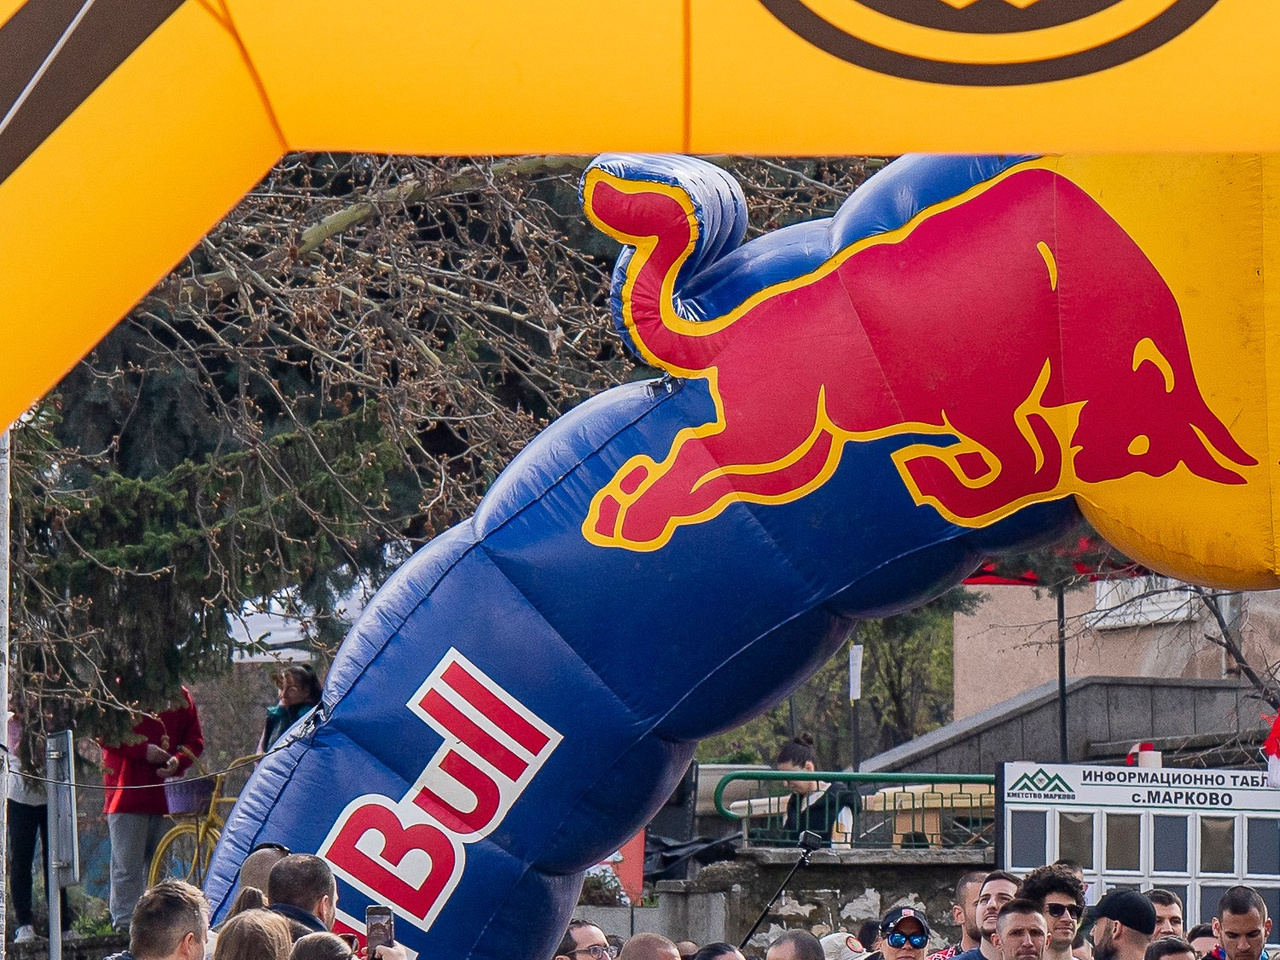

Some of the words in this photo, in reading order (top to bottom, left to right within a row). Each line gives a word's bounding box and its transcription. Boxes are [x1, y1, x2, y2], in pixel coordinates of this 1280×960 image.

[1082, 769, 1225, 788] ИНФОРМАЦИОННО
[1230, 774, 1270, 788] ТАБЛ
[320, 650, 560, 928] Bull
[1131, 791, 1233, 807] с.МАРКОВО
